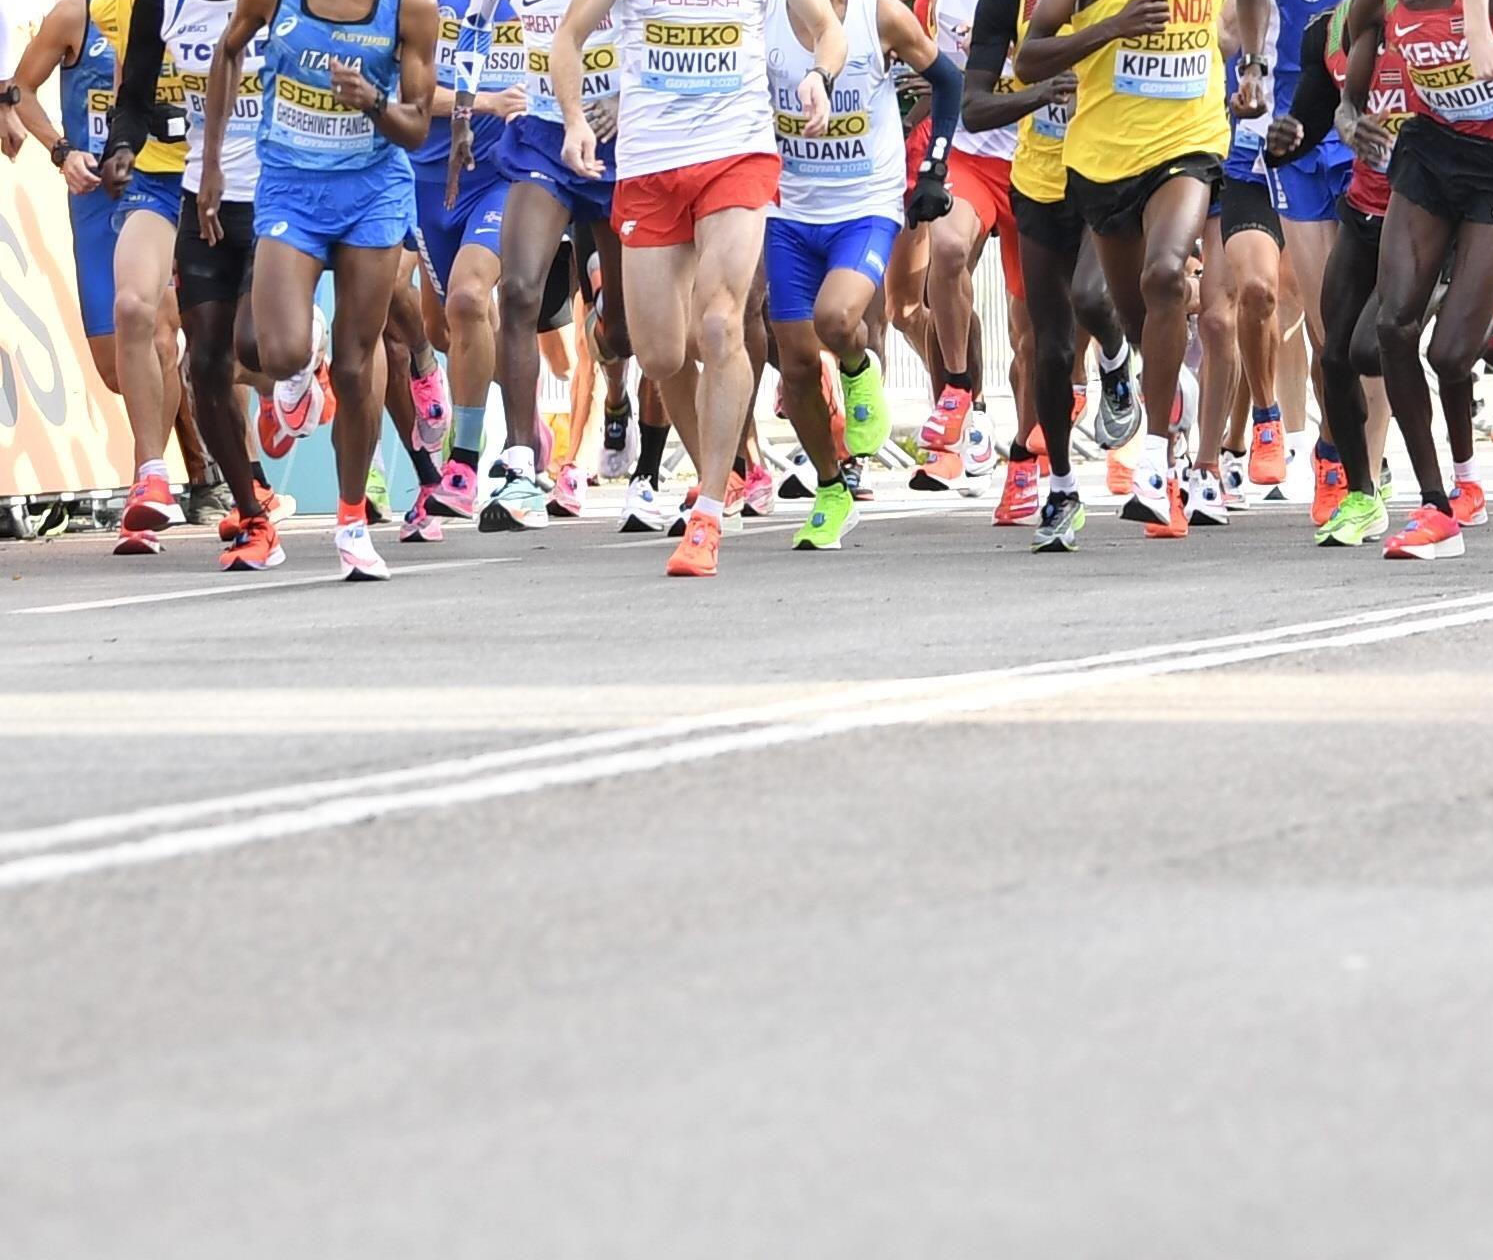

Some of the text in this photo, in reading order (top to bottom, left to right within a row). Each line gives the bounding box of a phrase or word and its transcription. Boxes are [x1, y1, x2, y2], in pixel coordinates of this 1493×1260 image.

[645, 24, 740, 46] SEIKO
[1122, 28, 1210, 53] SEIKO
[648, 49, 737, 74] NOWICKI
[1121, 54, 1207, 78] KIPLIMO
[1408, 63, 1475, 89] SEIK
[778, 88, 793, 111] EL
[339, 116, 371, 136] FANIEL
[781, 140, 866, 161] ALDANA
